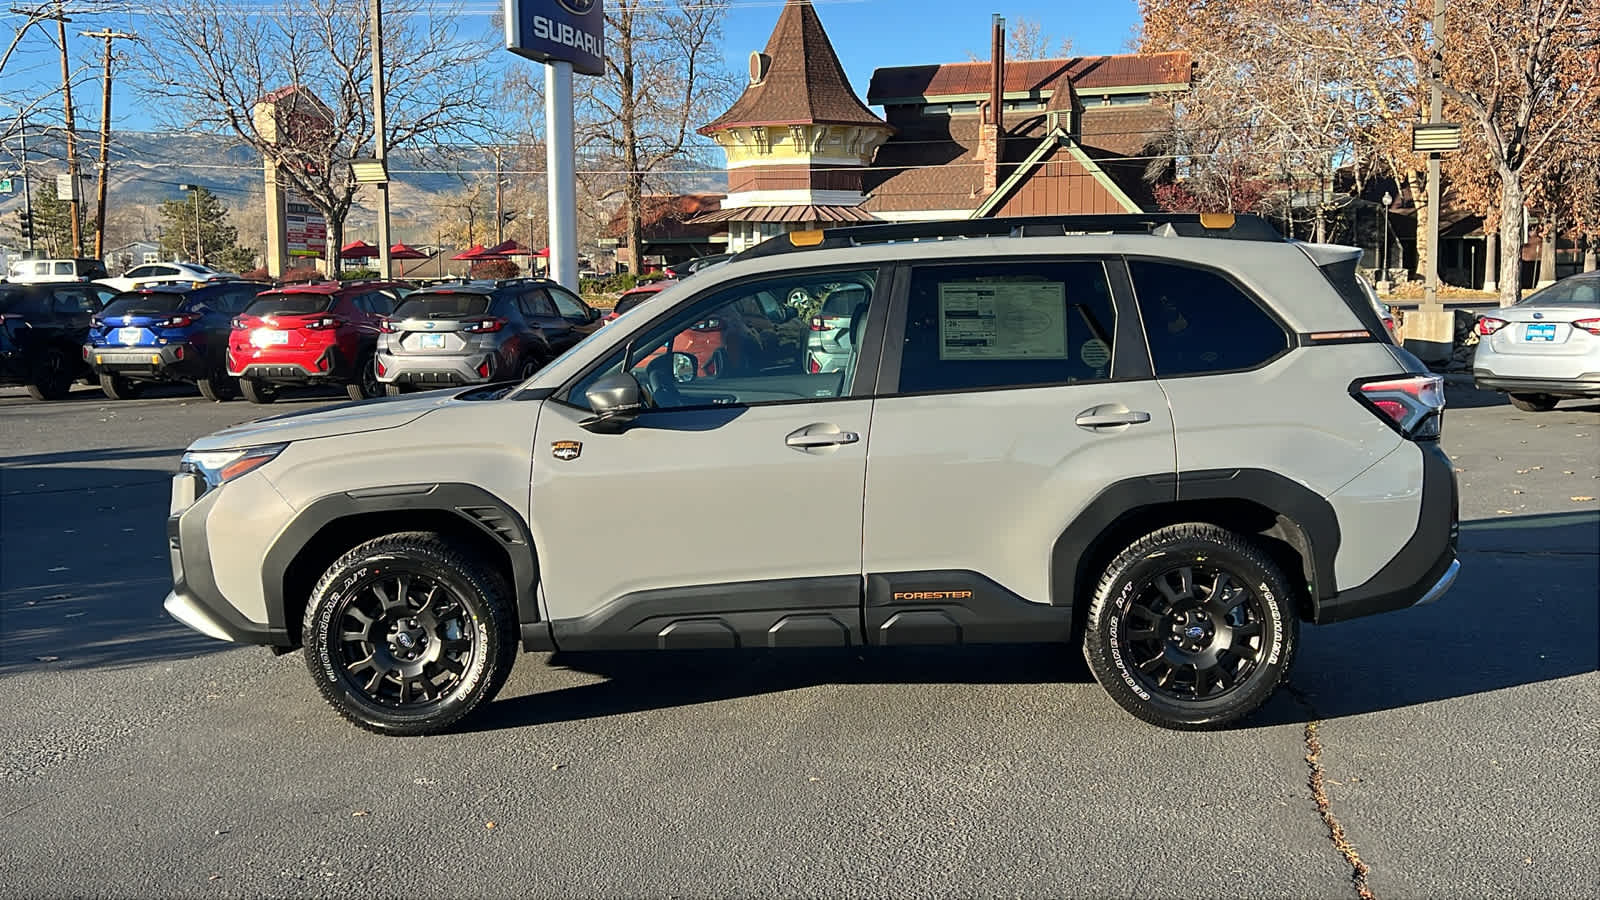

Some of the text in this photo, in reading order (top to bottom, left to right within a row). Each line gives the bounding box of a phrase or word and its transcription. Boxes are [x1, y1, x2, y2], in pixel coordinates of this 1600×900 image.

[533, 15, 602, 58] SUBARU
[320, 568, 367, 682] GEOLANDAR A/T
[894, 591, 972, 600] FORESTER
[1259, 582, 1282, 664] YOKOHAMA
[457, 622, 489, 701] YOKOHAMA
[1110, 581, 1150, 701] GEOLANDAR A/T
